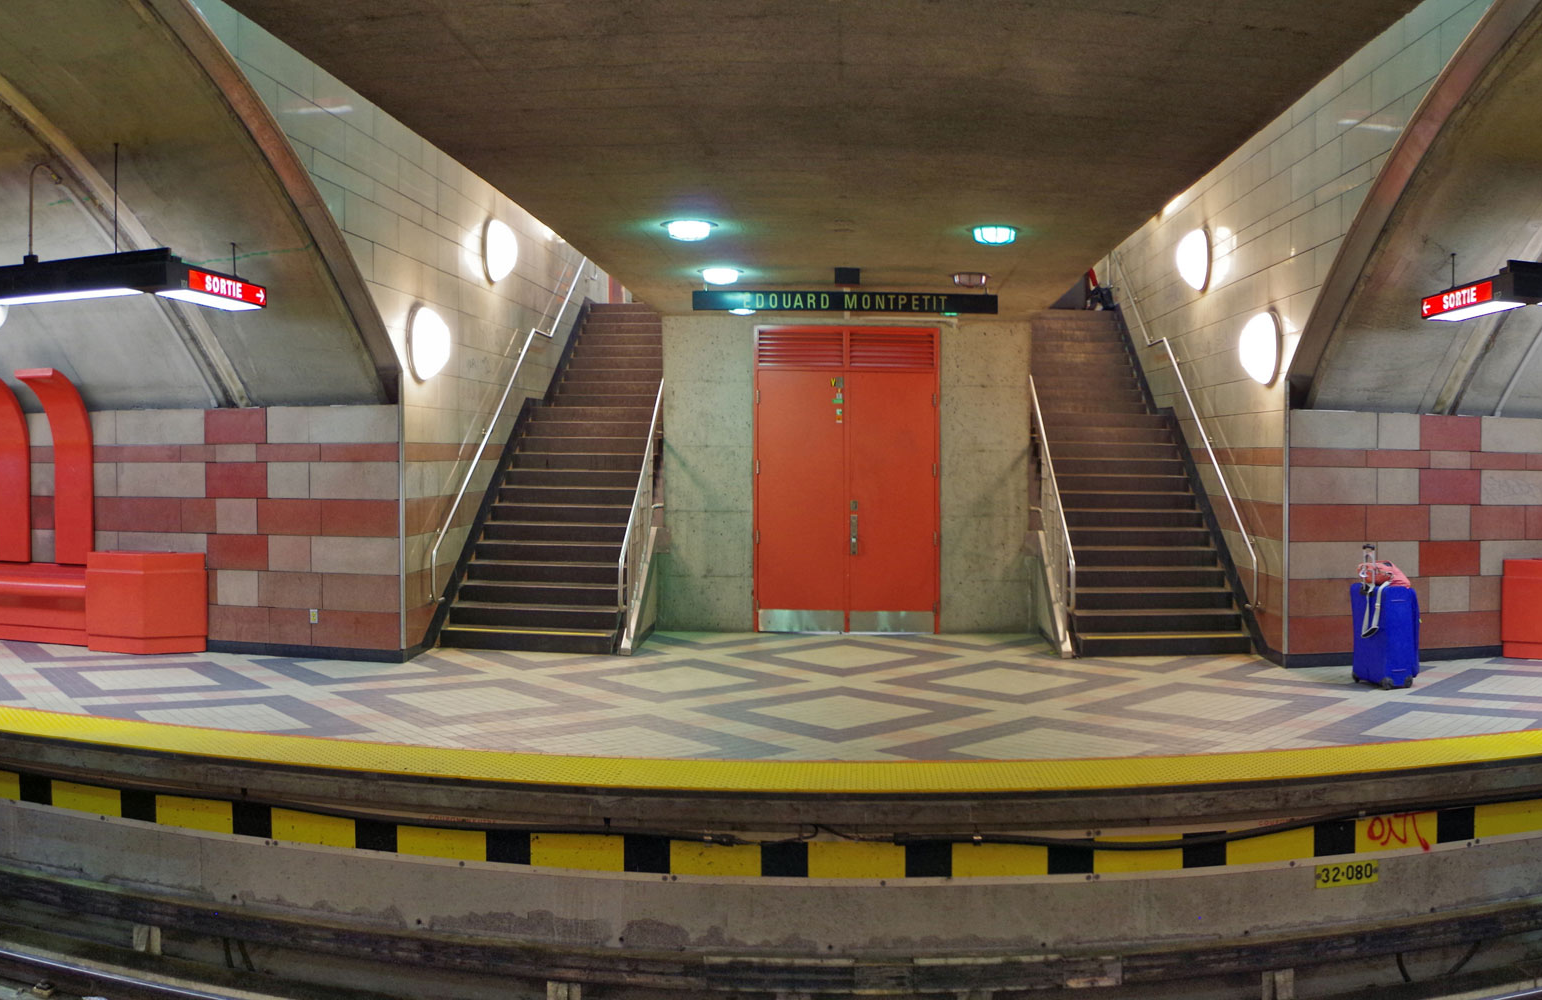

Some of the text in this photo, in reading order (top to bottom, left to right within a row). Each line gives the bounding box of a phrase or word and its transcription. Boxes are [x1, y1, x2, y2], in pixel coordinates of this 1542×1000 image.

[205, 275, 243, 299] SORTIE
[1442, 286, 1477, 310] SORTIE
[844, 293, 948, 311] MONTPETIT
